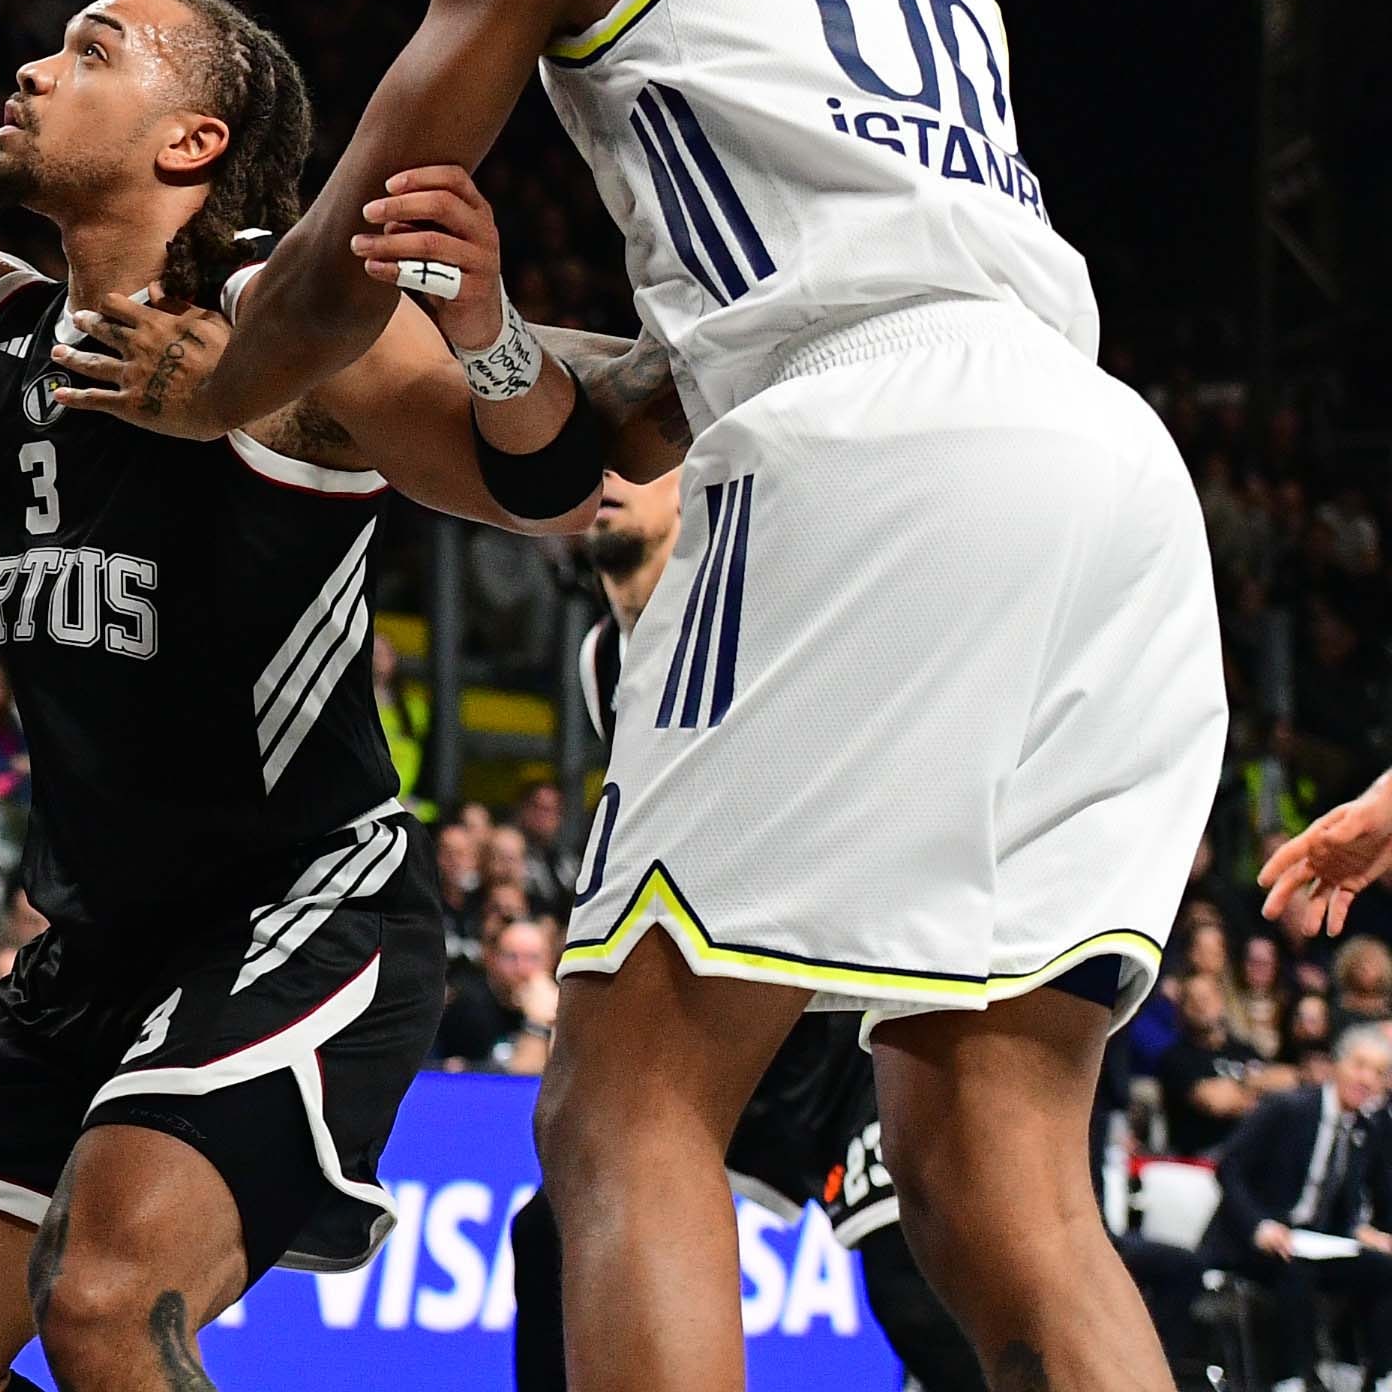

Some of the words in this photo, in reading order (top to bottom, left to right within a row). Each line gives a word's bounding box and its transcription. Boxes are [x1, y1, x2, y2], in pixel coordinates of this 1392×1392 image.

[19, 439, 60, 535] 3
[120, 986, 183, 1065] 3
[736, 1191, 861, 1339] SA
